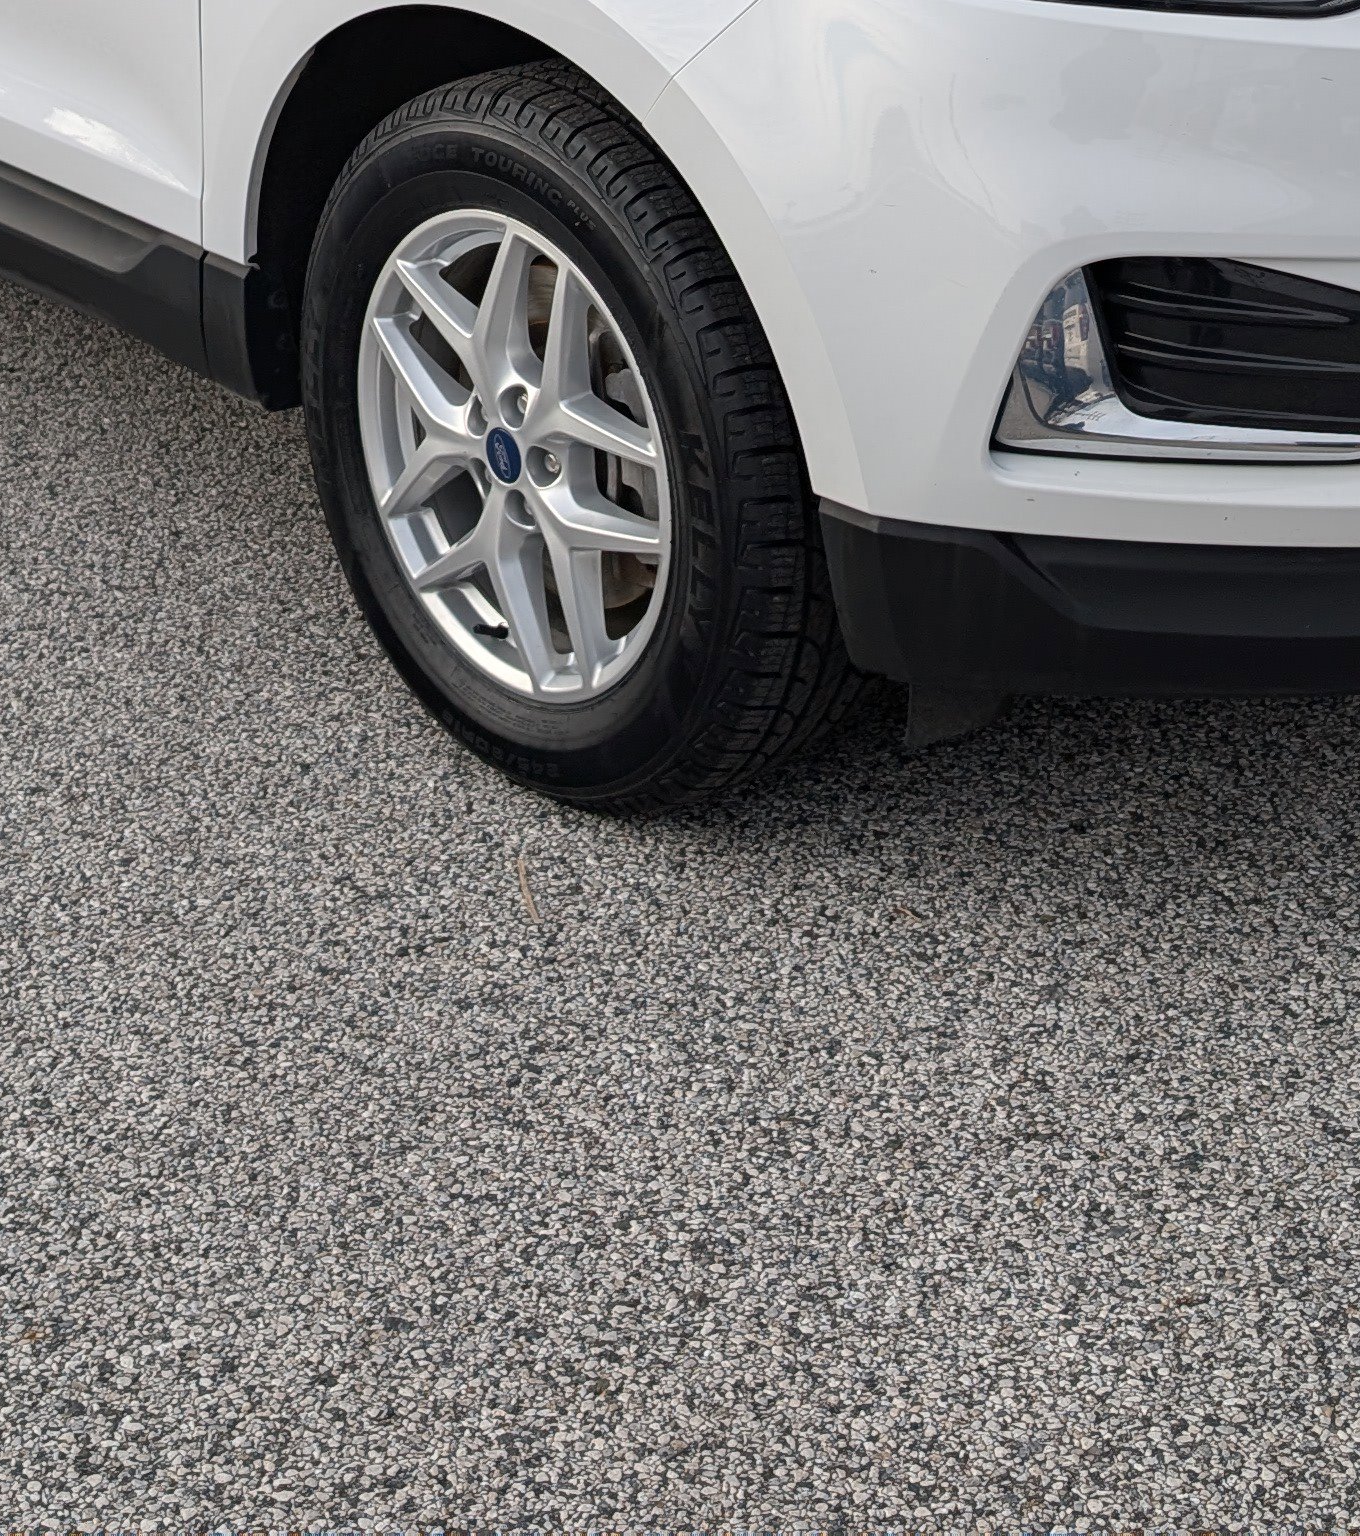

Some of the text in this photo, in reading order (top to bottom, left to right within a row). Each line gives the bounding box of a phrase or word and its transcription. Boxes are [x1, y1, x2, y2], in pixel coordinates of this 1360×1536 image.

[471, 145, 564, 206] TOURING
[566, 199, 597, 232] PLUS
[677, 430, 718, 642] KELLY
